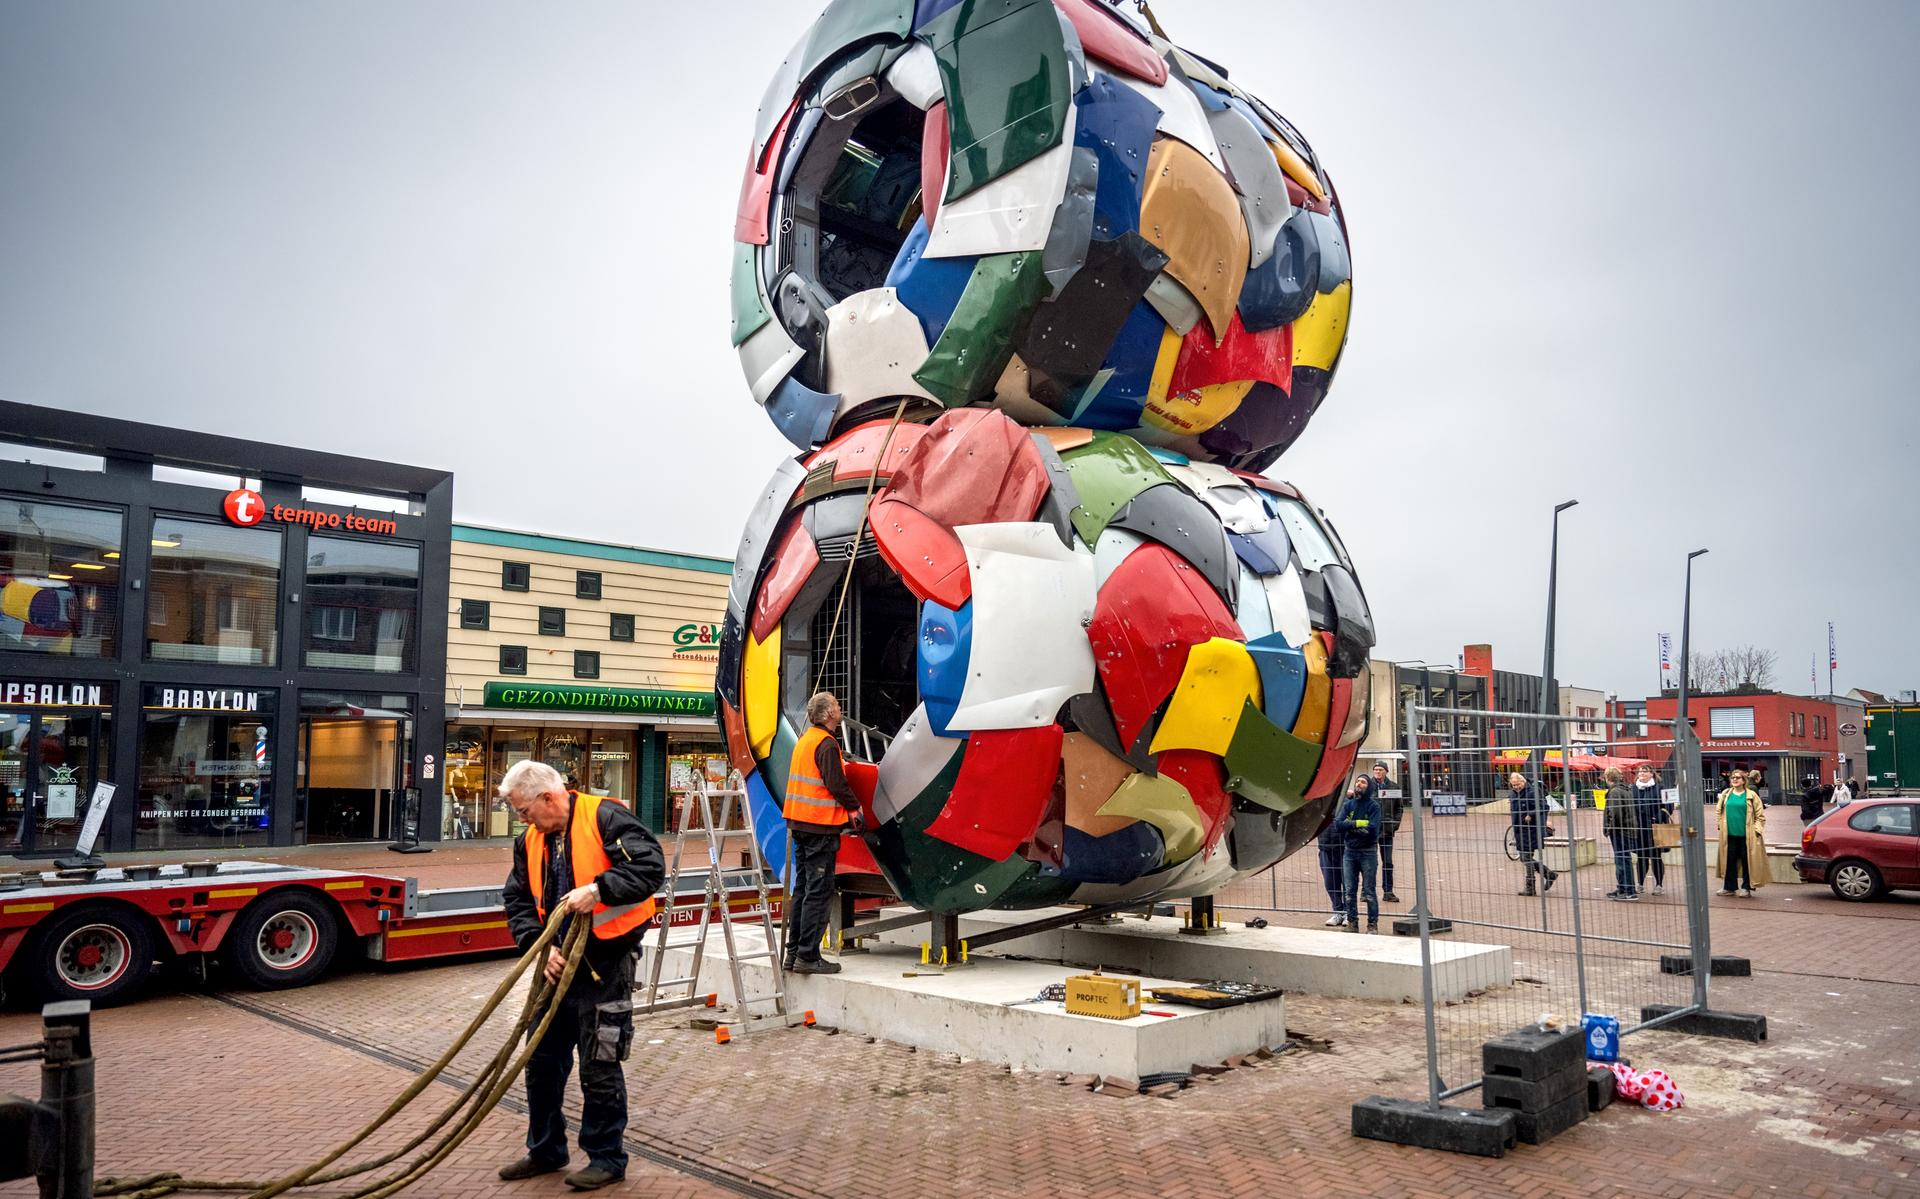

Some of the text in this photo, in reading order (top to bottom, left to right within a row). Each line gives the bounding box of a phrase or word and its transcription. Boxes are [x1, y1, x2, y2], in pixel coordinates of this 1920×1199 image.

[272, 503, 341, 531] tempo
[345, 512, 397, 534] team
[673, 652, 719, 661] Gezondheids
[0, 683, 258, 711] PSALON BABYLON
[502, 689, 706, 711] GEZONDHEIDSWINKEL
[1705, 740, 1770, 748] Raadhuys
[141, 810, 171, 818] KNIPPEN
[173, 809, 188, 817] MET
[231, 808, 265, 816] AFSPRAAK
[651, 909, 693, 924] ACTEN
[1076, 993, 1108, 1004] PROFTEC
